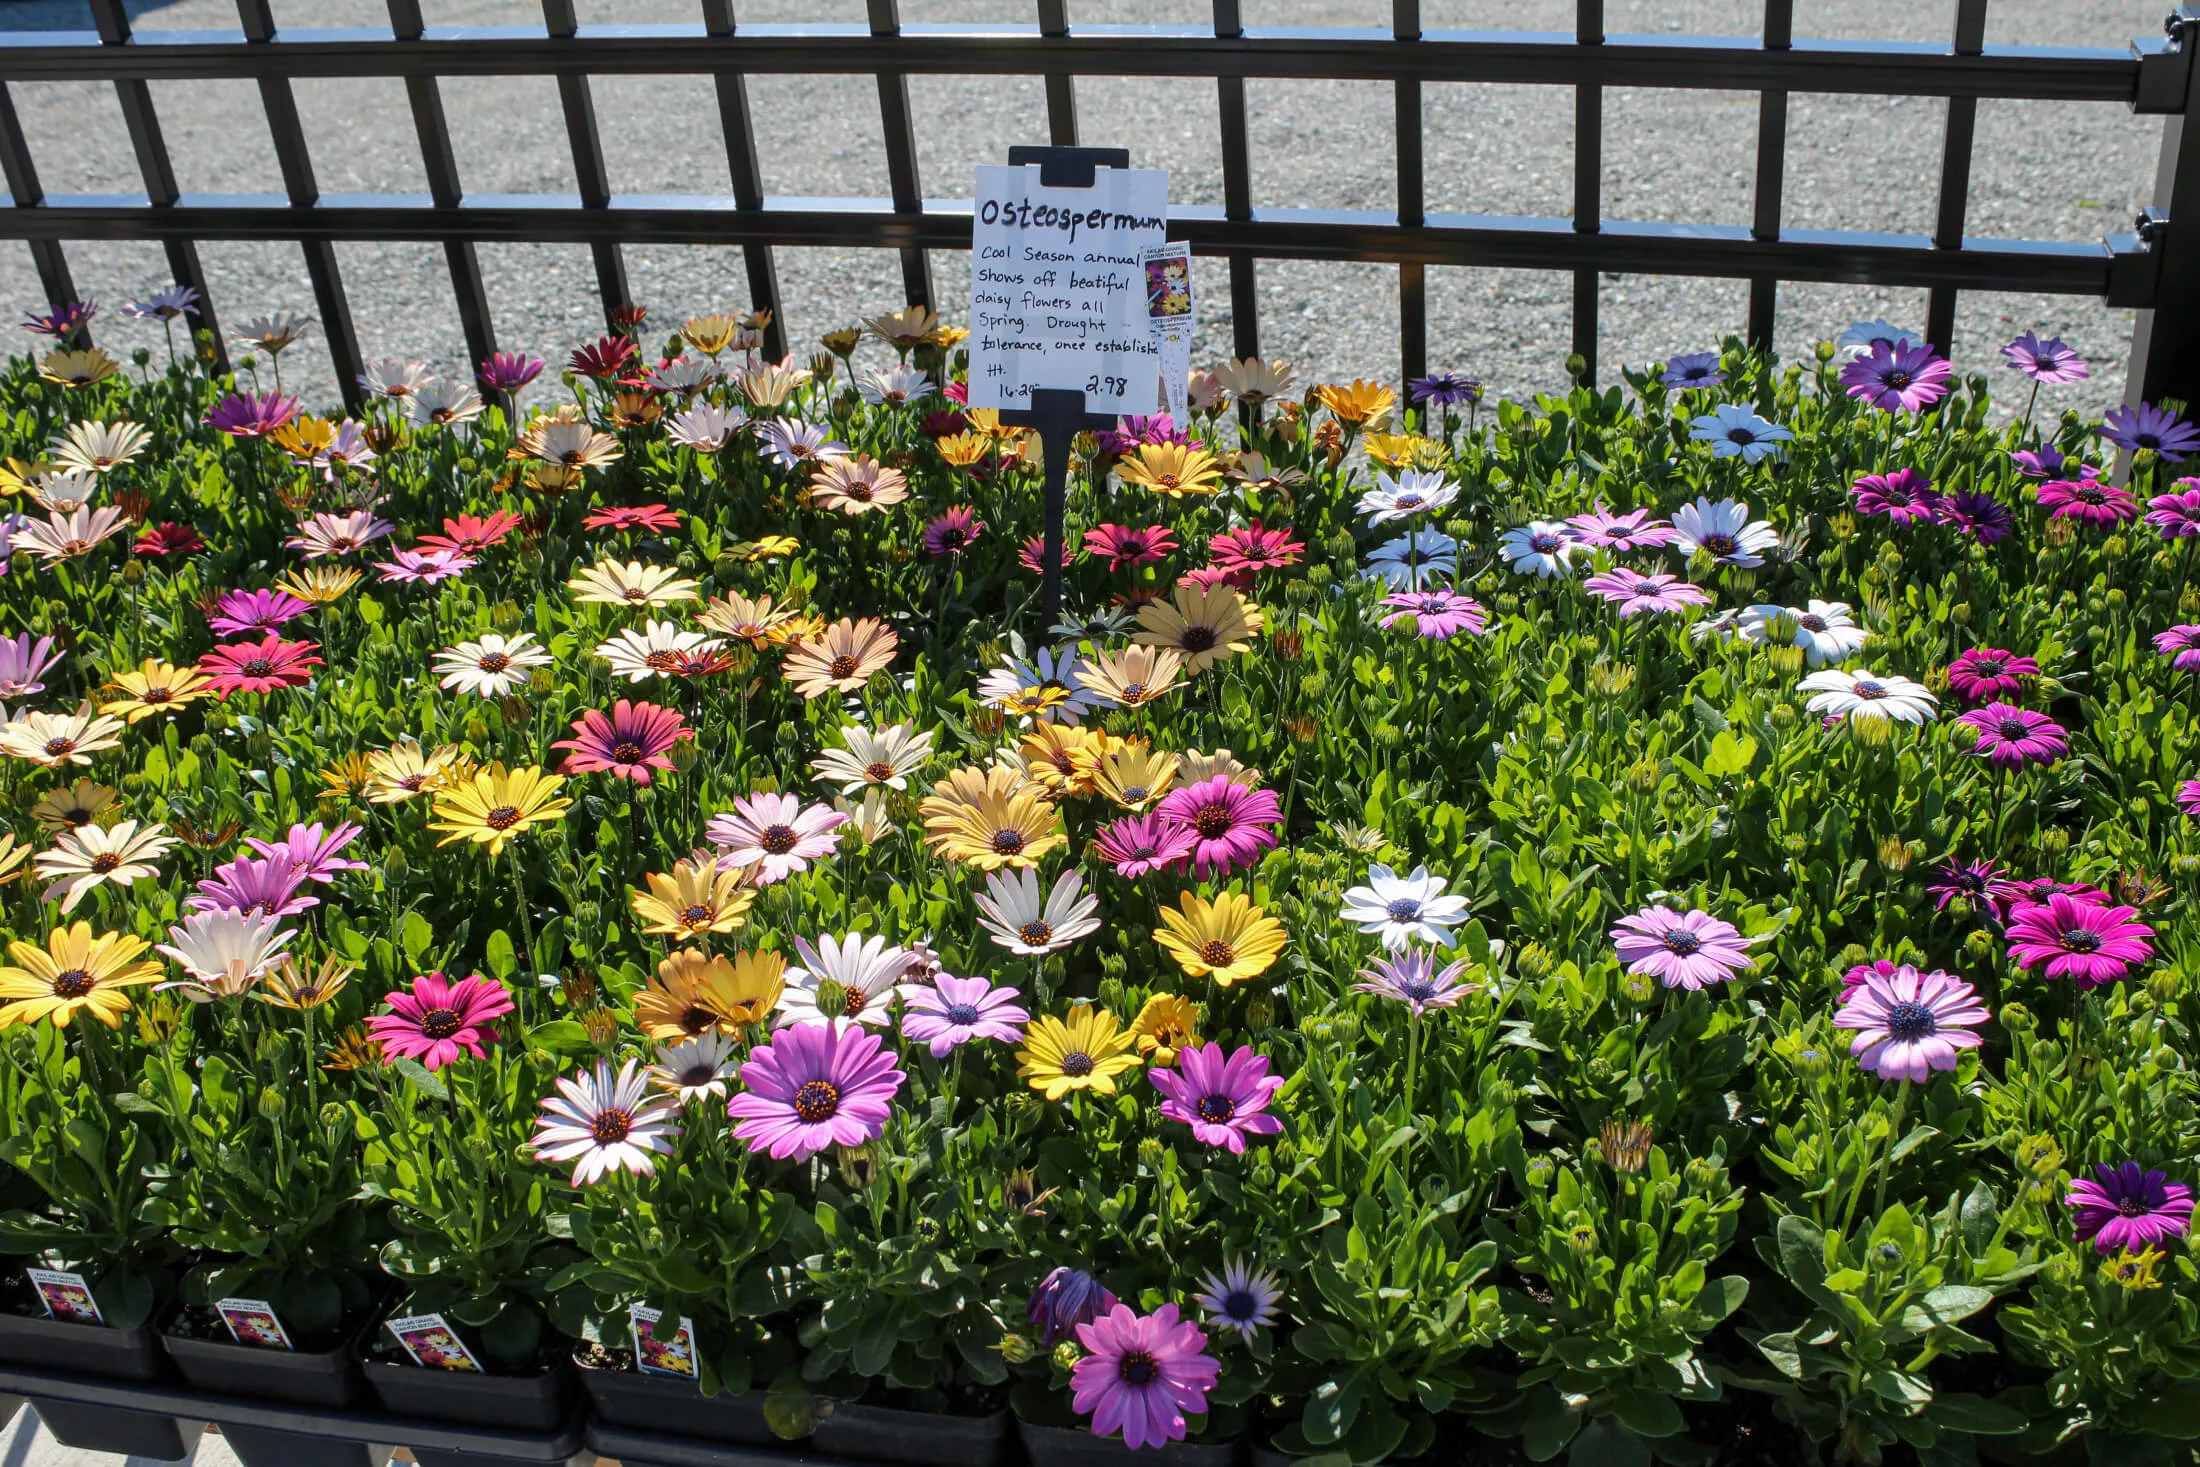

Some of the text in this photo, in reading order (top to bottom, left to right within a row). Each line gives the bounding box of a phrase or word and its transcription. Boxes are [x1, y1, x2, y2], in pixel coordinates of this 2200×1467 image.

[982, 196, 1165, 245] Osteospermum
[981, 245, 1141, 268] Cool Season annual
[1033, 270, 1057, 288] off
[1070, 271, 1130, 296] beatiful
[975, 290, 1104, 314] daisy flowers all
[1046, 315, 1107, 338] Drought
[981, 334, 1047, 356] tolerance,
[1085, 375, 1129, 398] 2.98
